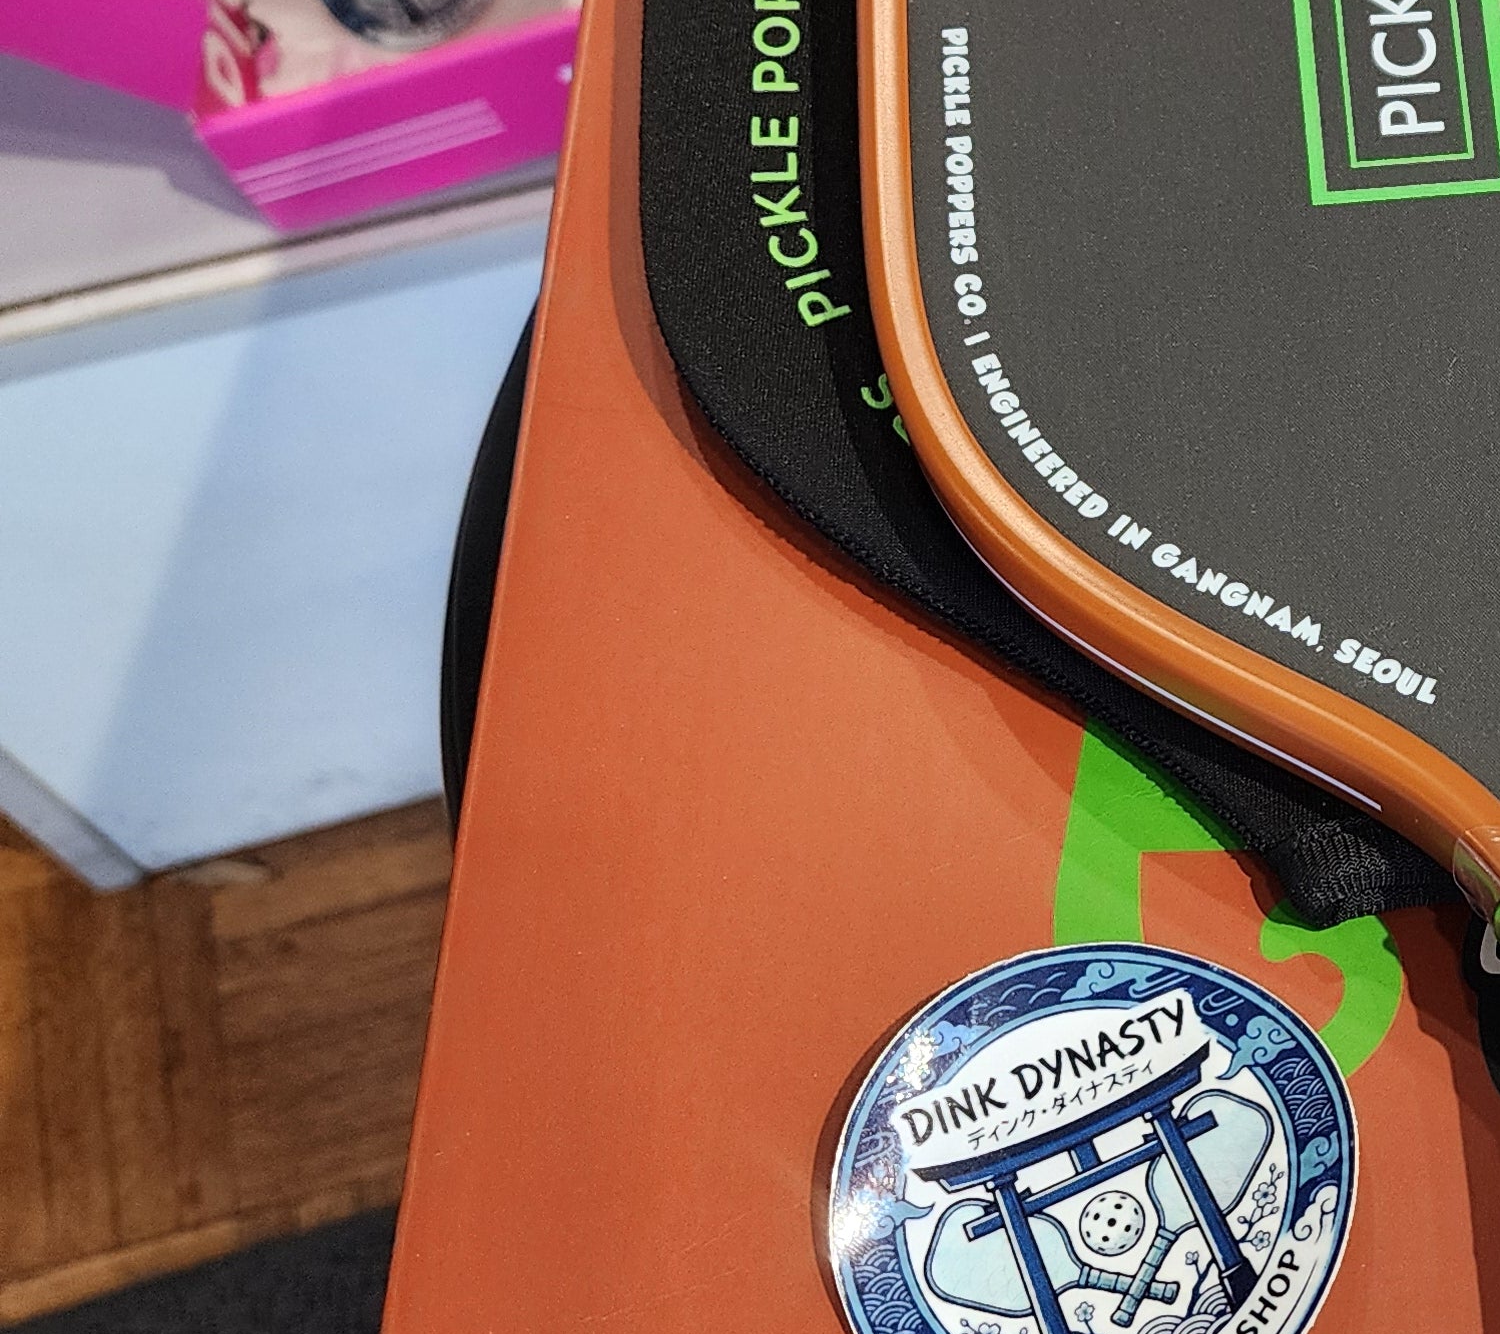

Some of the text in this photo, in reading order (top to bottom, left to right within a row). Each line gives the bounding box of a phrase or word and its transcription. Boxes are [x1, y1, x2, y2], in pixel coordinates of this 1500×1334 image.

[940, 27, 972, 127] PICKLE
[750, 114, 854, 328] PICKLE
[944, 135, 980, 265] POPPERS
[971, 352, 1110, 519] ENGINEERED
[1107, 513, 1153, 550] IN
[1151, 542, 1325, 653] GANGNAM,
[1333, 638, 1437, 705] SEOUL
[899, 998, 1184, 1147] DINK DYNASTY
